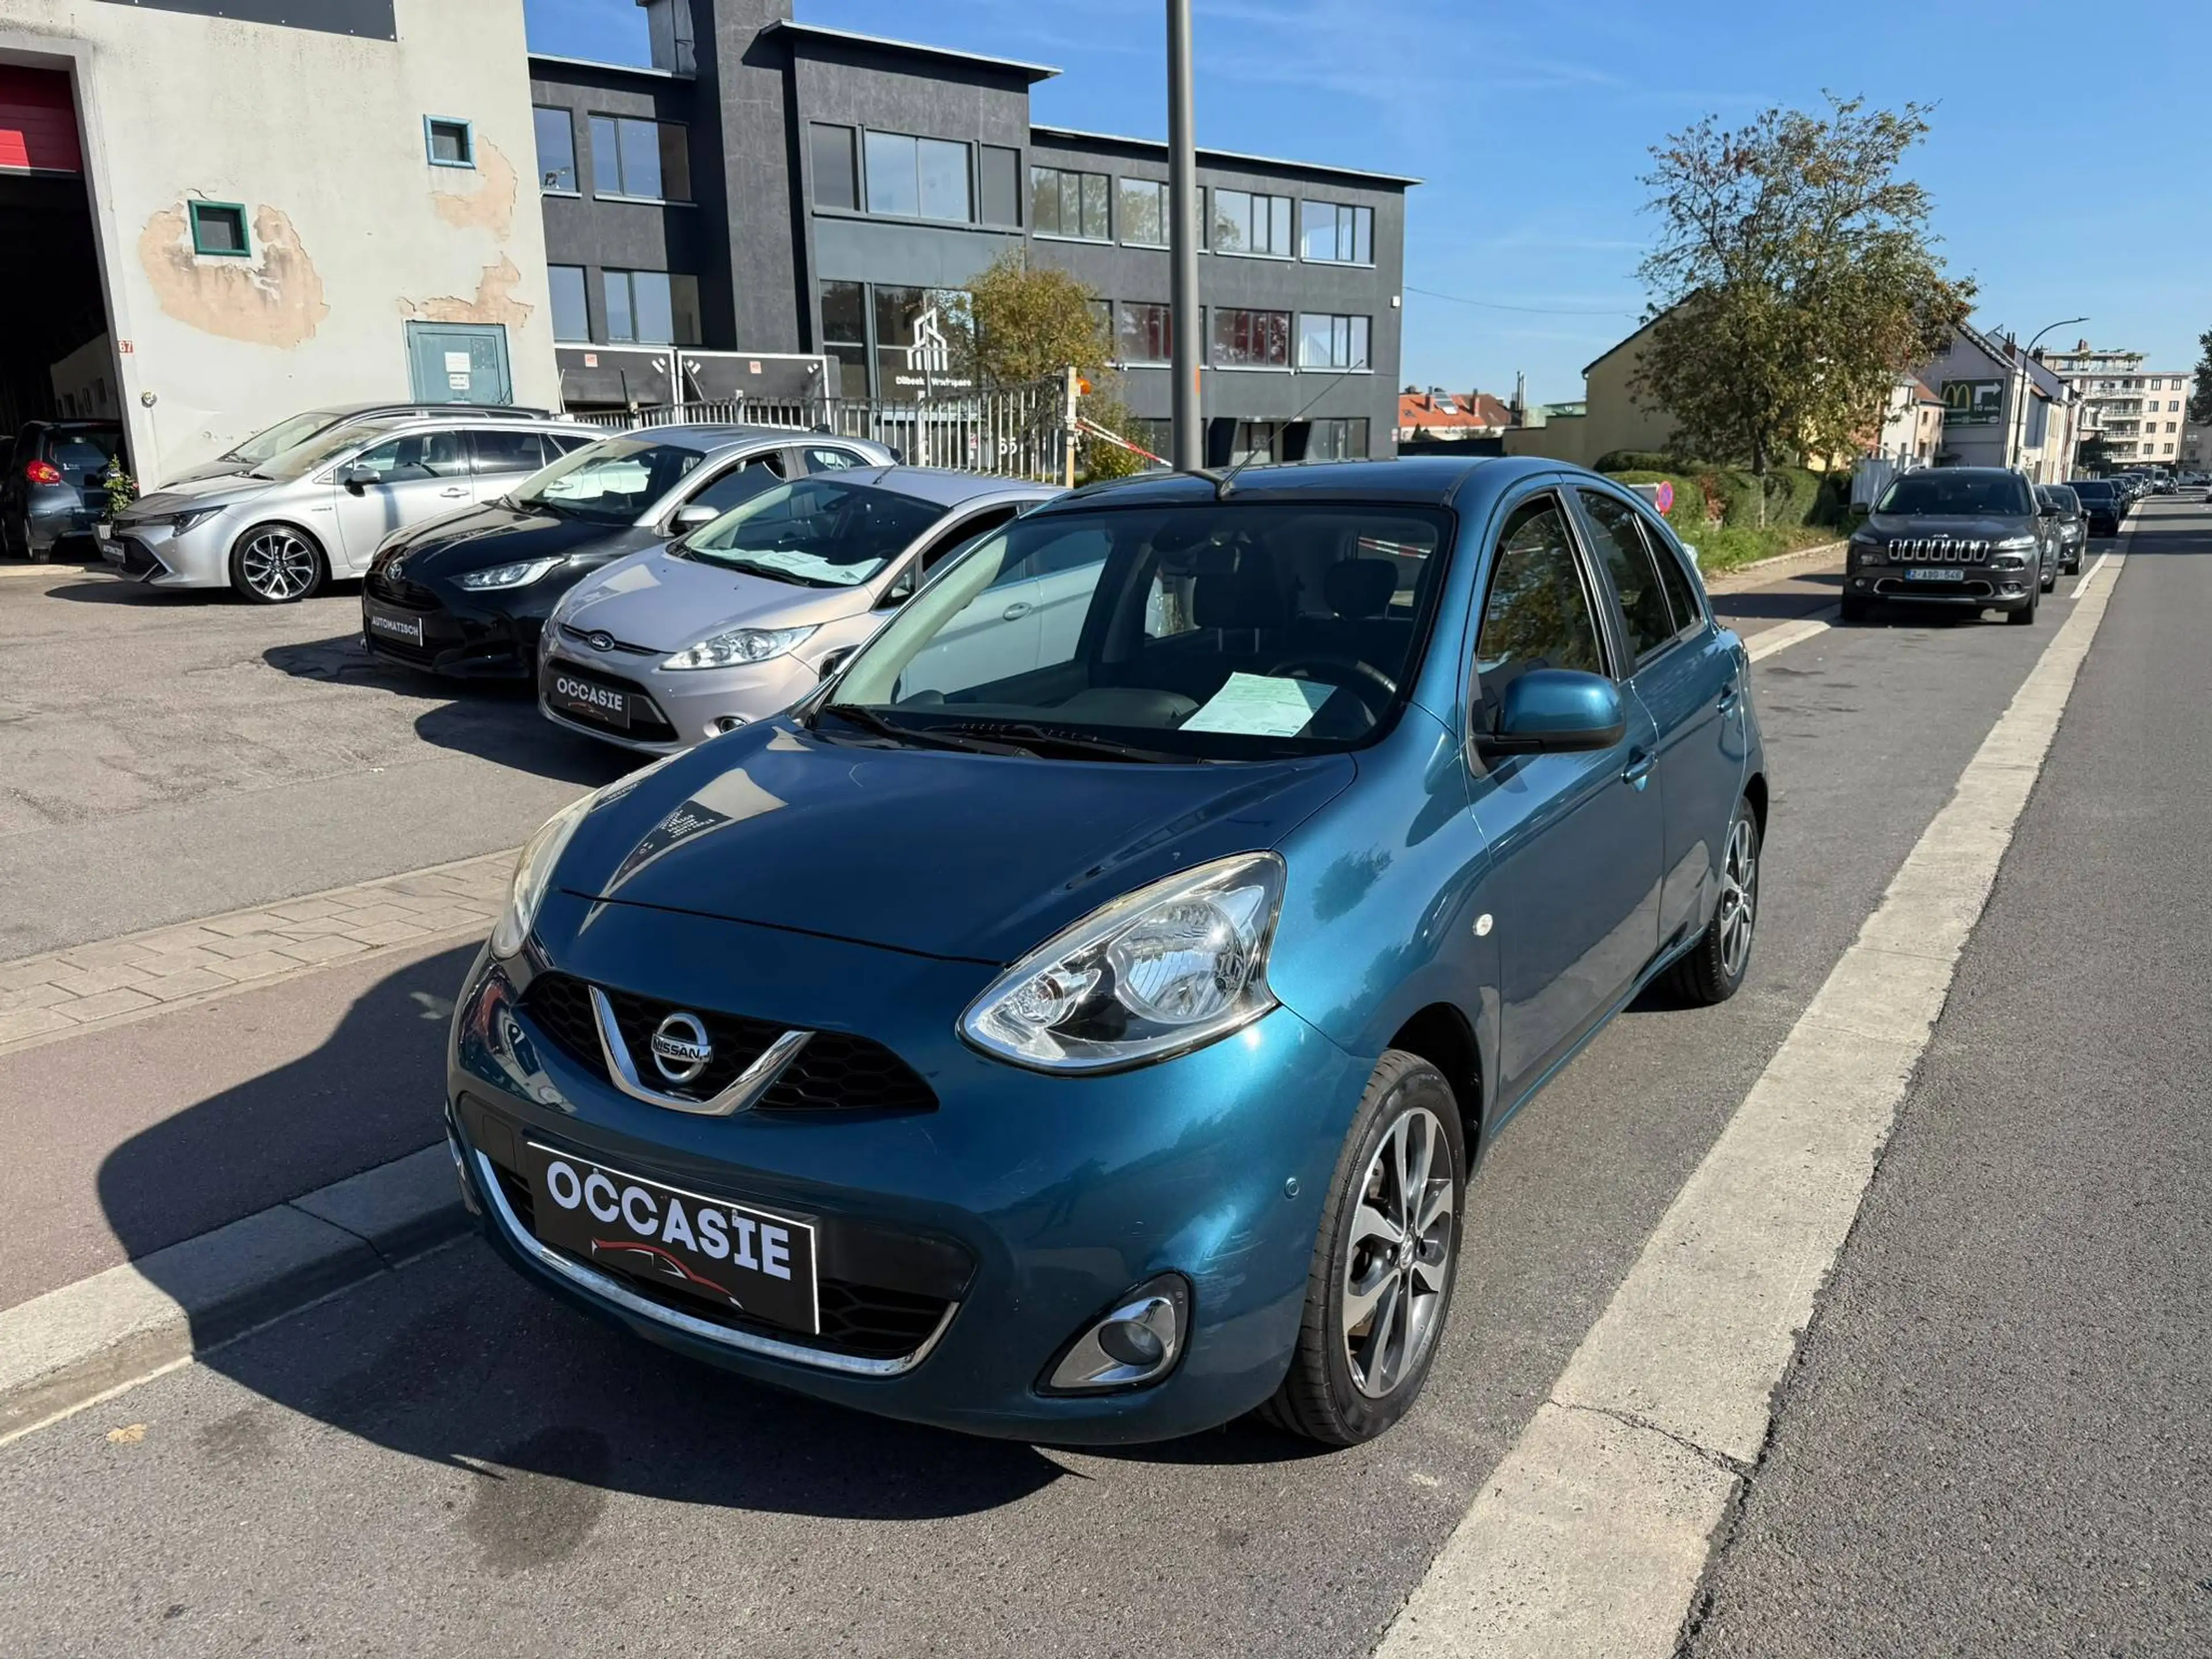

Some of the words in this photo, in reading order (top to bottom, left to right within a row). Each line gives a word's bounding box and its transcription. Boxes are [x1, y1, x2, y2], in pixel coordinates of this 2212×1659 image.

[372, 615, 419, 637] AUTOMATISCH
[556, 678, 623, 711] OCCASIE
[653, 1036, 700, 1059] NISSAN
[547, 1160, 791, 1281] OCCASIE
